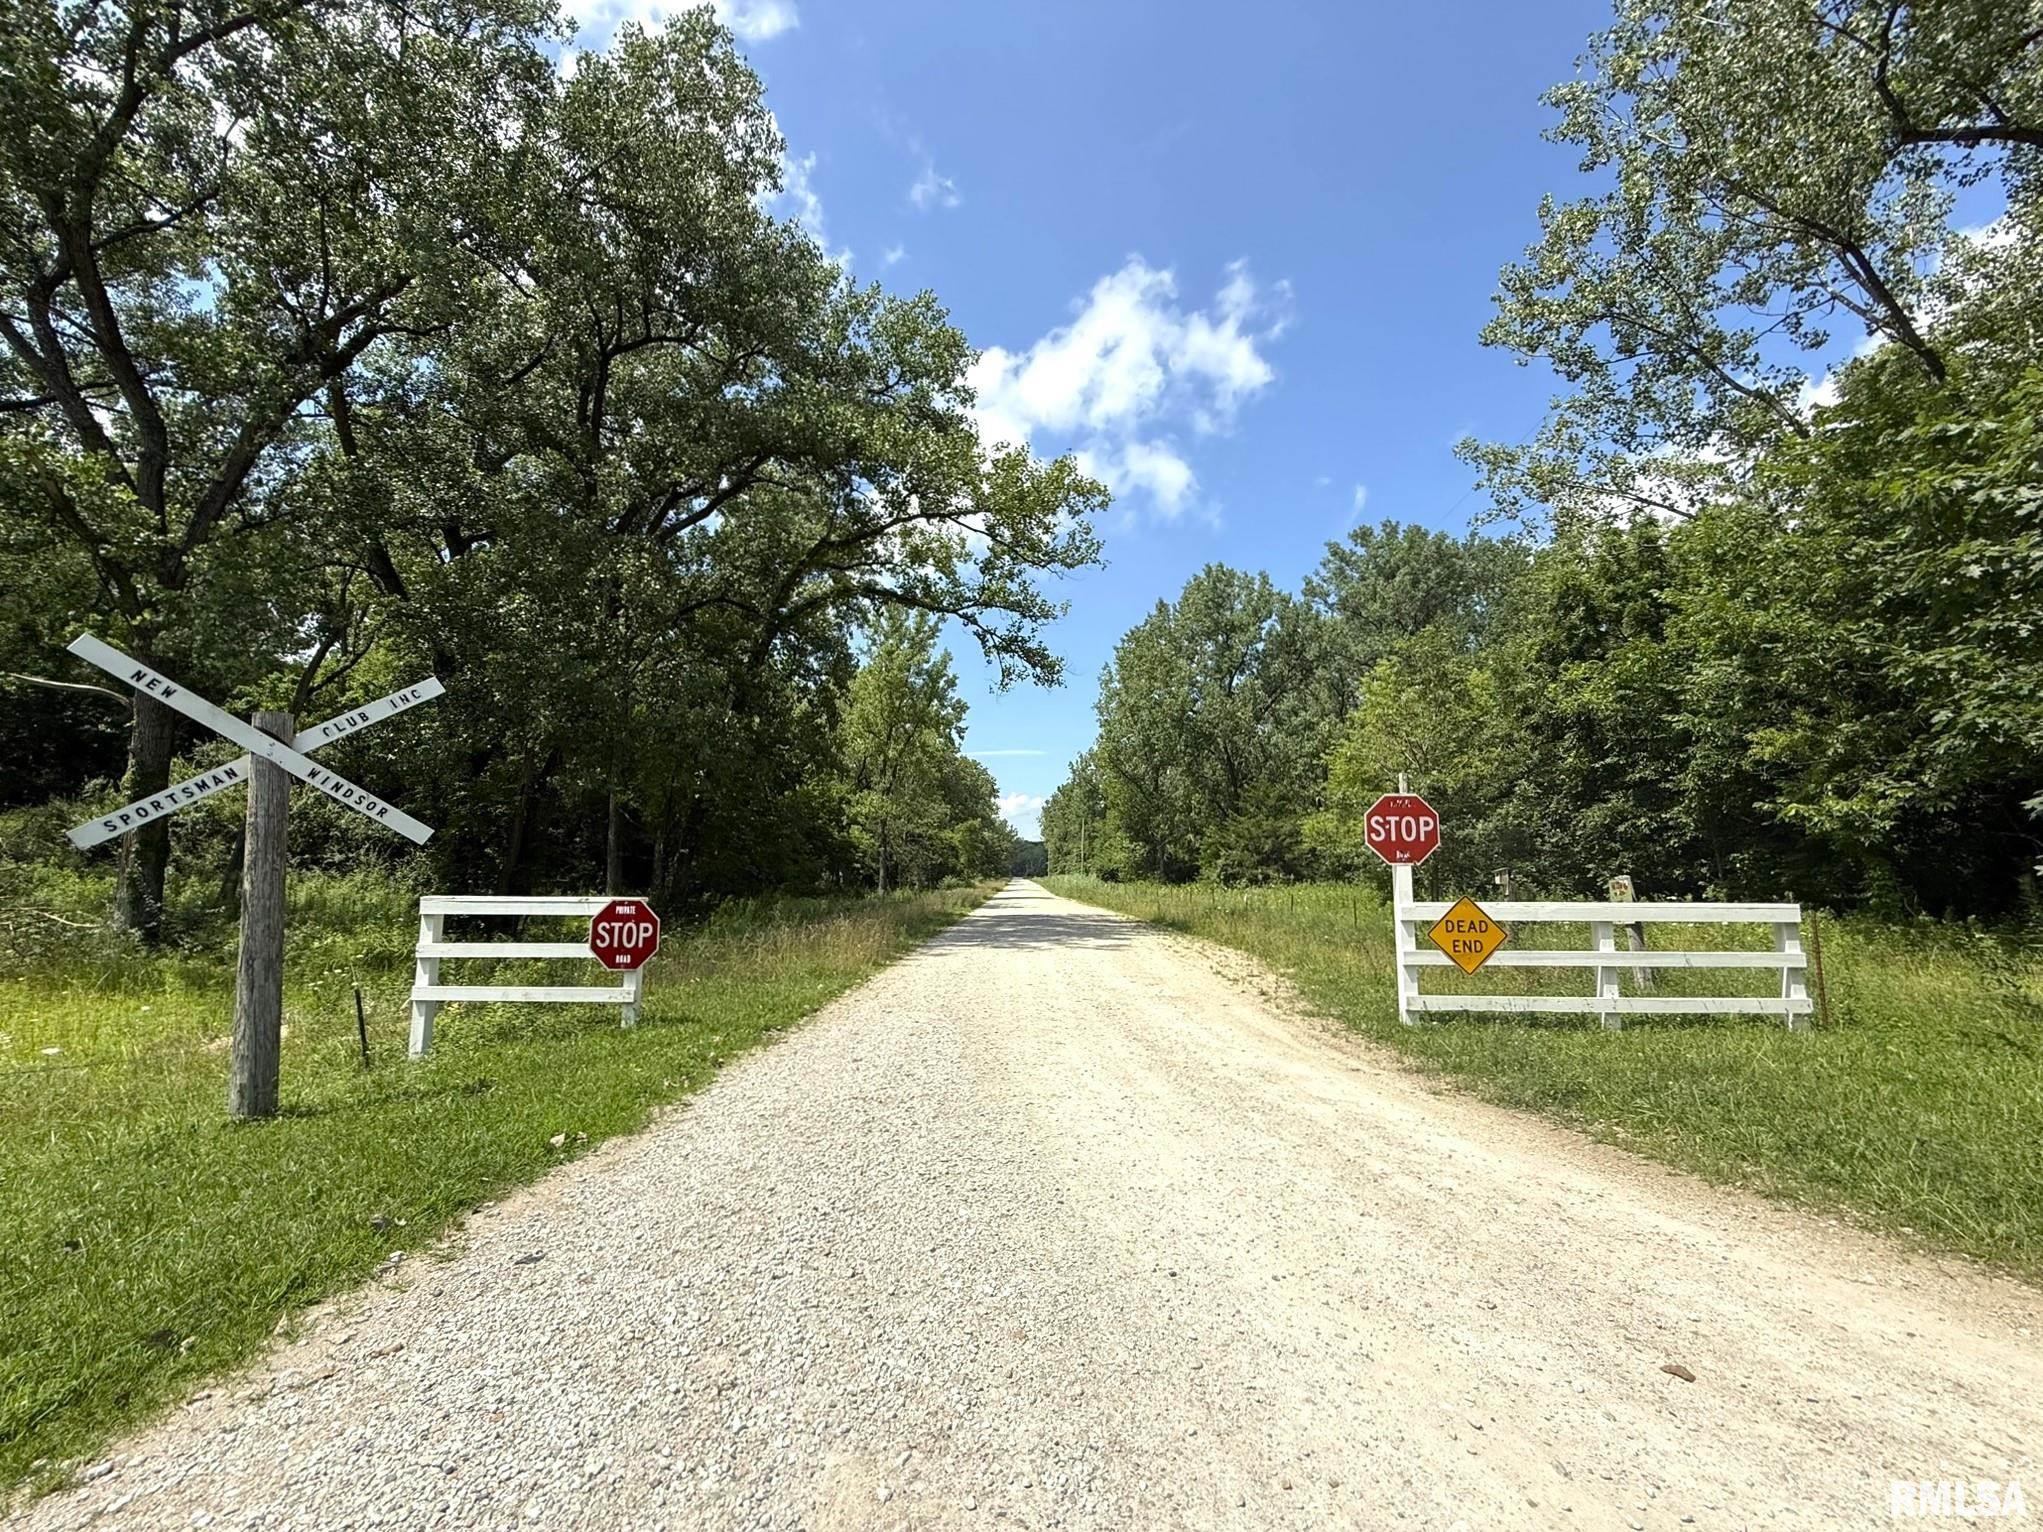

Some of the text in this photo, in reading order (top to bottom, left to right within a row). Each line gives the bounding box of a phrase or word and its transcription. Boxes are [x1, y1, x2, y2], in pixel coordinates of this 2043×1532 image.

[130, 669, 389, 818] NEW WINDSOR
[103, 689, 422, 832] SPORTSMAN CLUB INC
[1370, 815, 1434, 842] STOP
[596, 921, 653, 948] STOP
[1445, 919, 1488, 933] DEAD
[615, 954, 631, 964] ROAD
[1452, 940, 1484, 953] END
